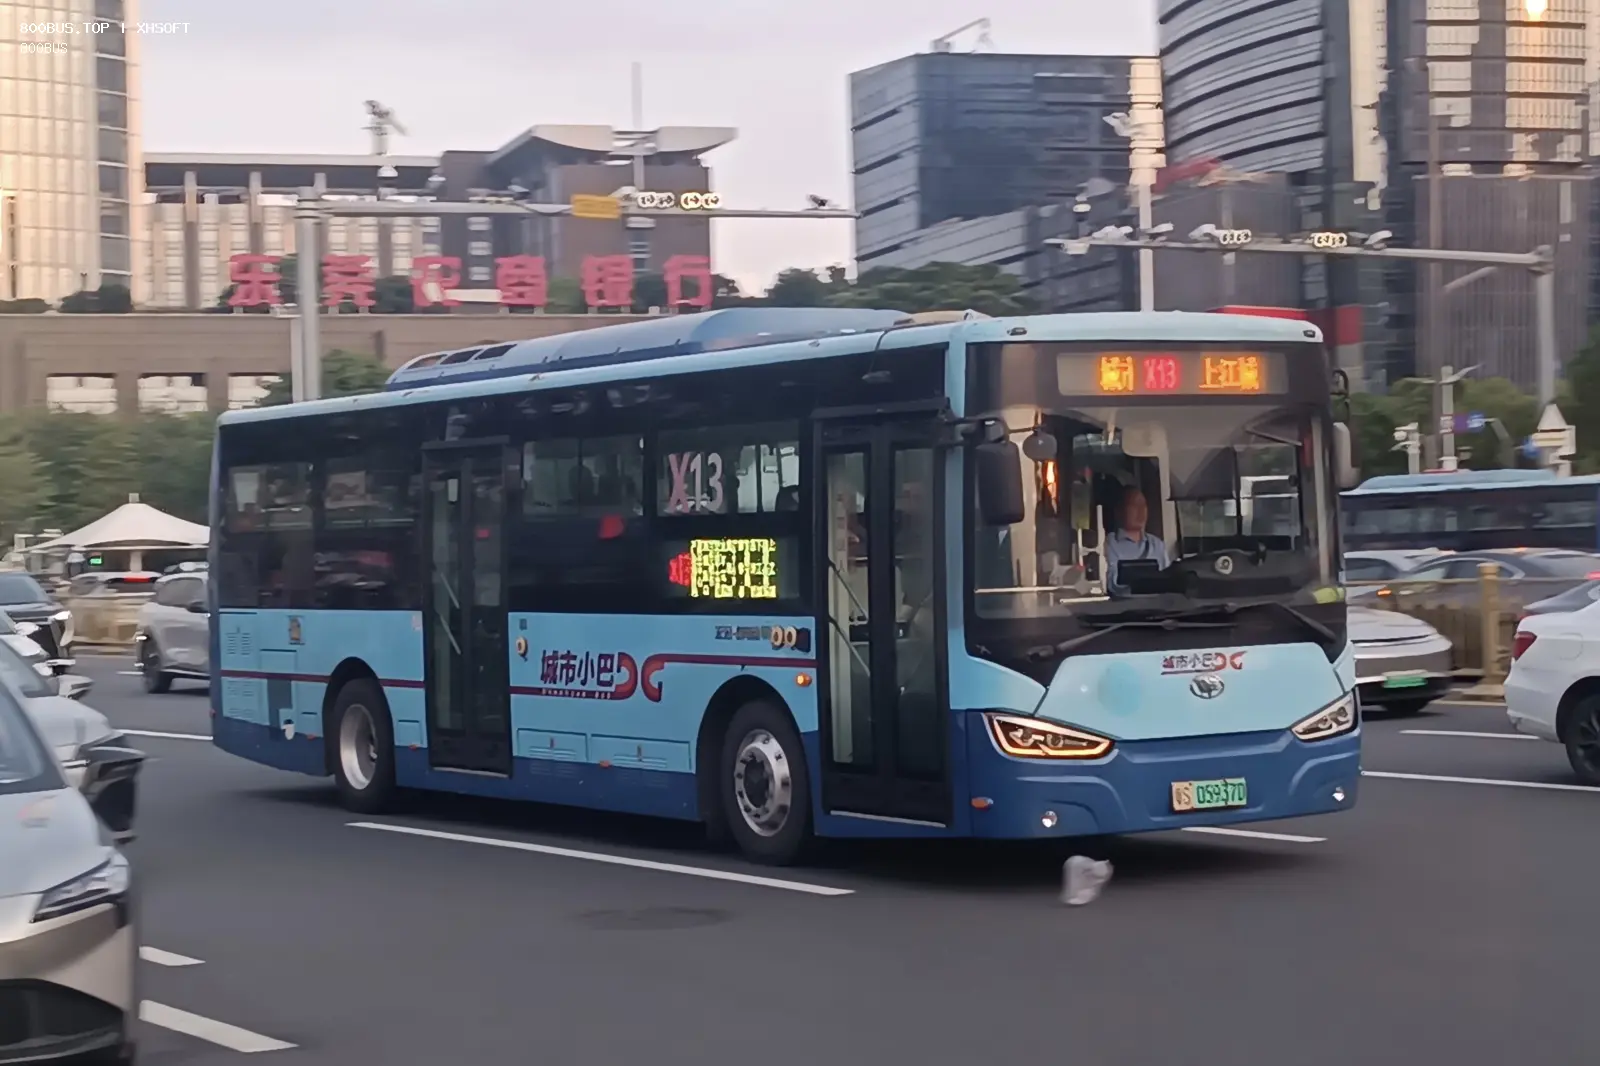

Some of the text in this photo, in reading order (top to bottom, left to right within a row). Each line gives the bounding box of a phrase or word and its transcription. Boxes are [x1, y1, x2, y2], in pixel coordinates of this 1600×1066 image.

[1199, 355, 1260, 391] 上江
[668, 451, 724, 514] X13
[540, 649, 615, 687] 城市小巴
